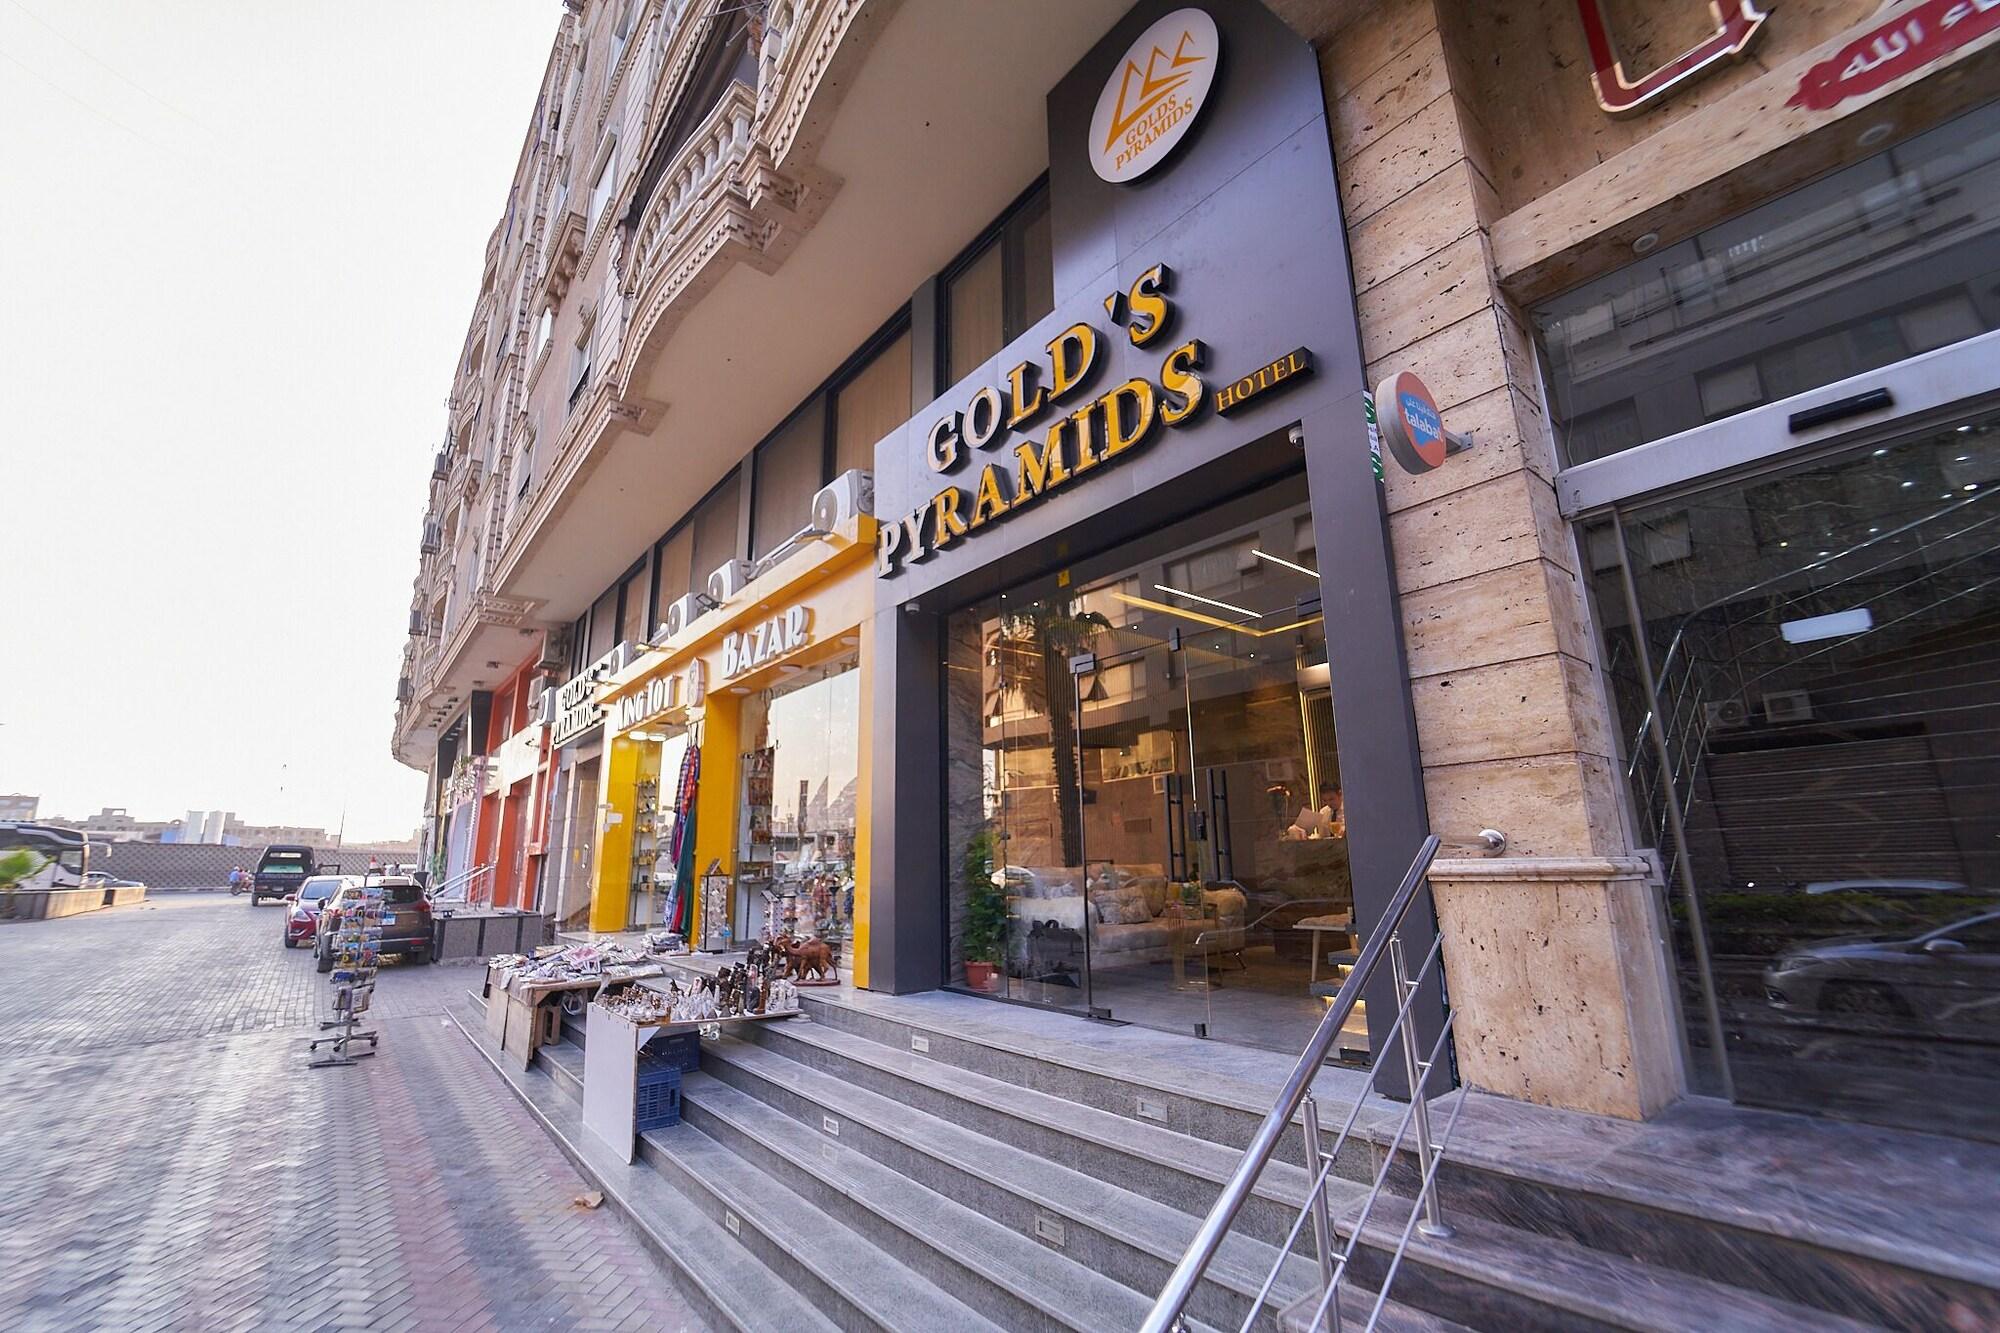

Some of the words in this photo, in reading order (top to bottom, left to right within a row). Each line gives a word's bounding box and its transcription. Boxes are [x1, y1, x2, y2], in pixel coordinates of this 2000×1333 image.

[1115, 97, 1194, 171] PYRAMIDS
[1125, 94, 1177, 146] GOLDS
[927, 263, 1171, 473] GOLD'S
[878, 339, 1206, 579] PYRAMIDS
[1216, 354, 1305, 412] HOTEL
[617, 690, 645, 731] KING
[646, 673, 677, 716] TOT
[722, 604, 810, 678] BAZAR
[553, 702, 595, 745] PYRAMIDS
